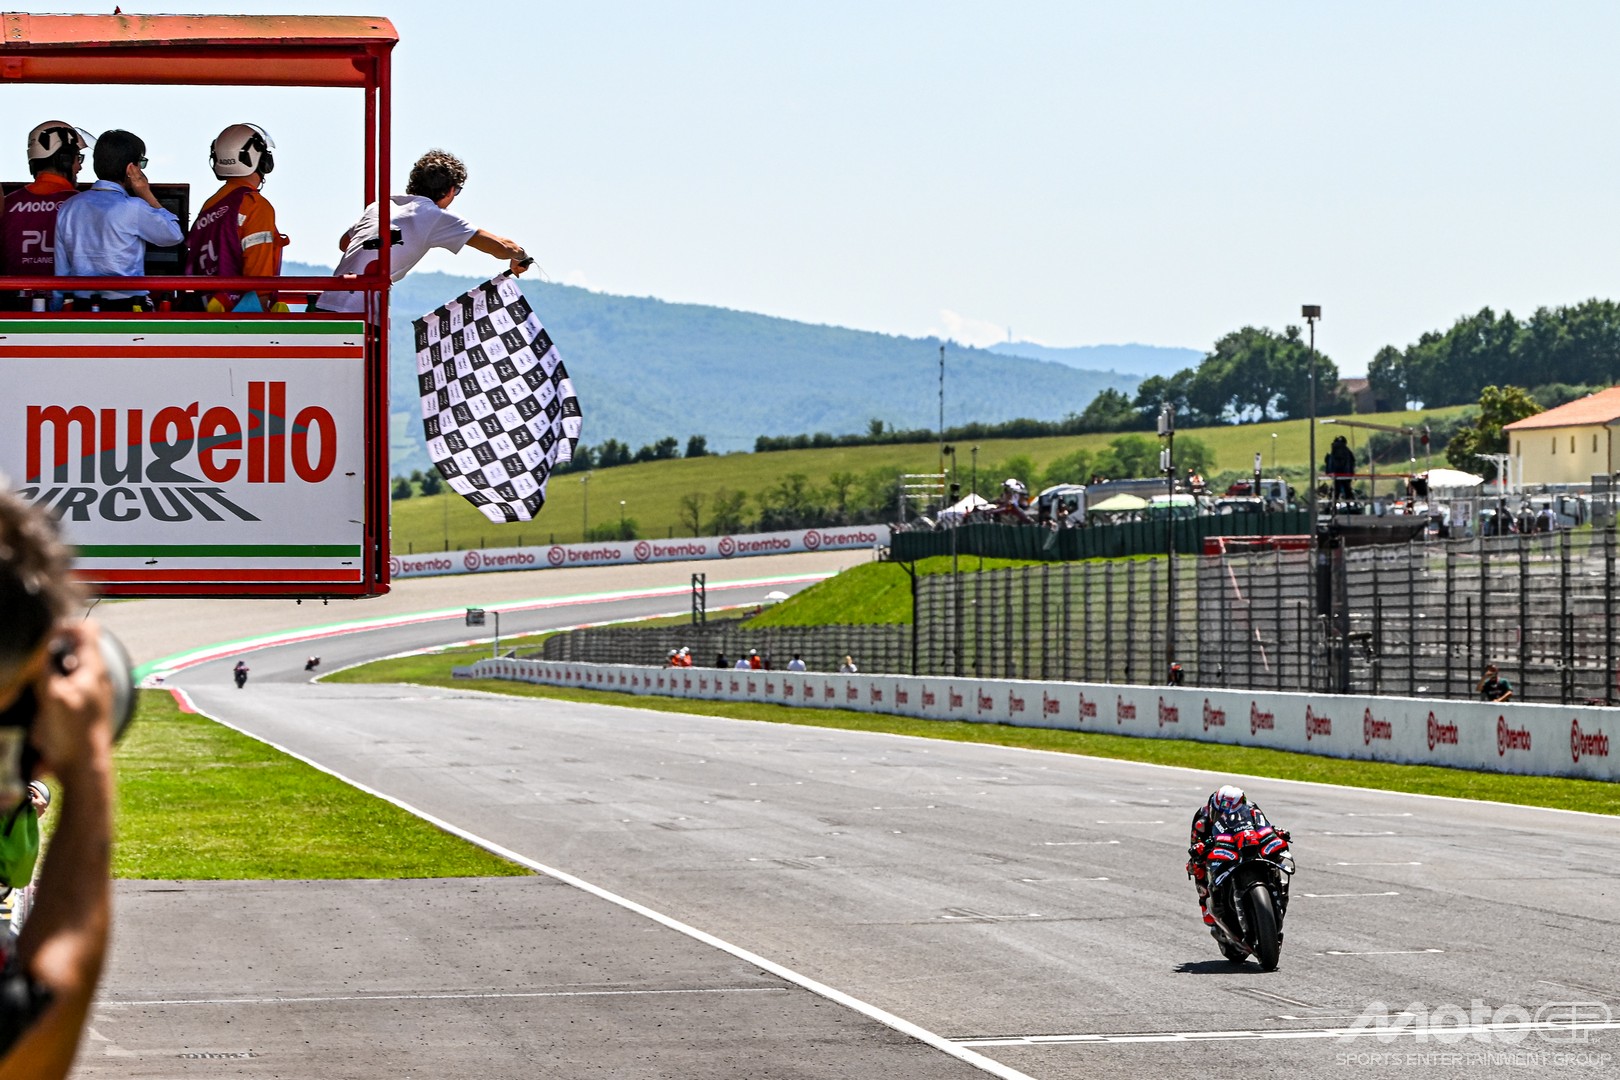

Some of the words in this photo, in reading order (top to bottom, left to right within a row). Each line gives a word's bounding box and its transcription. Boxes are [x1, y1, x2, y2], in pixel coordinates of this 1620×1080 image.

[26, 380, 337, 486] mugello
[737, 537, 791, 551] brembo
[823, 531, 877, 544] brembo
[568, 548, 621, 562] brembo
[653, 542, 707, 556] brembo
[402, 557, 452, 572] brembo
[483, 552, 535, 566] brembo
[1505, 723, 1531, 751] brembo
[1580, 728, 1609, 757] brembo
